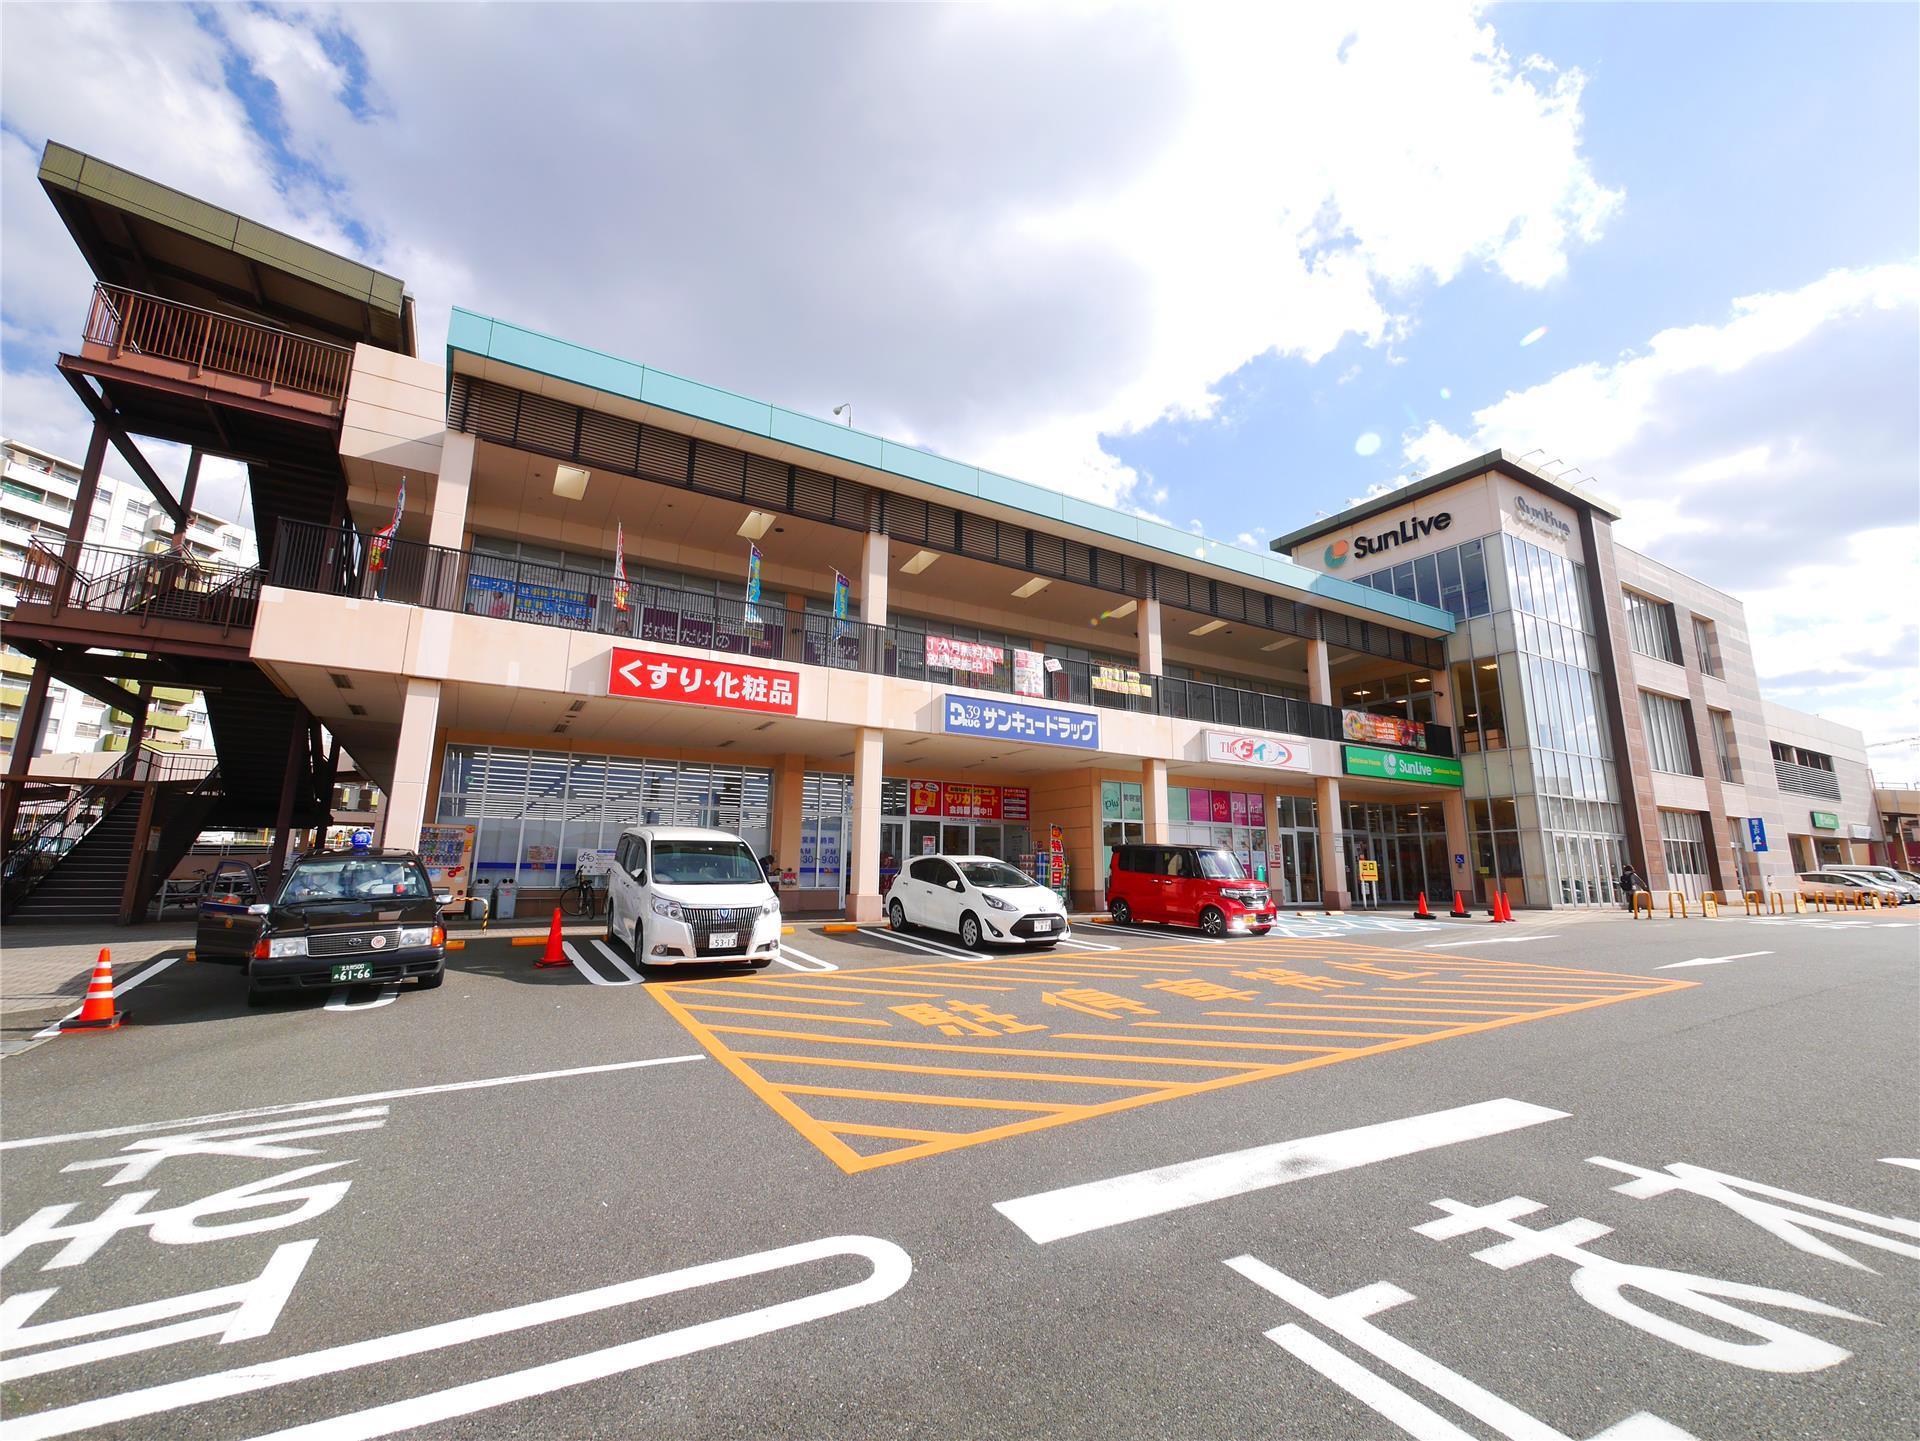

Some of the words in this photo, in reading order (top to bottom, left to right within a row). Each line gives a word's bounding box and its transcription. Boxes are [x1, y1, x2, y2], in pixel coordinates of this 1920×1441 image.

[1354, 511, 1452, 559] SunLive
[618, 659, 793, 706] くすり・化粧品
[965, 705, 981, 720] 39
[983, 706, 1097, 741] サンキュードラッグ
[1399, 758, 1433, 777] SunLive
